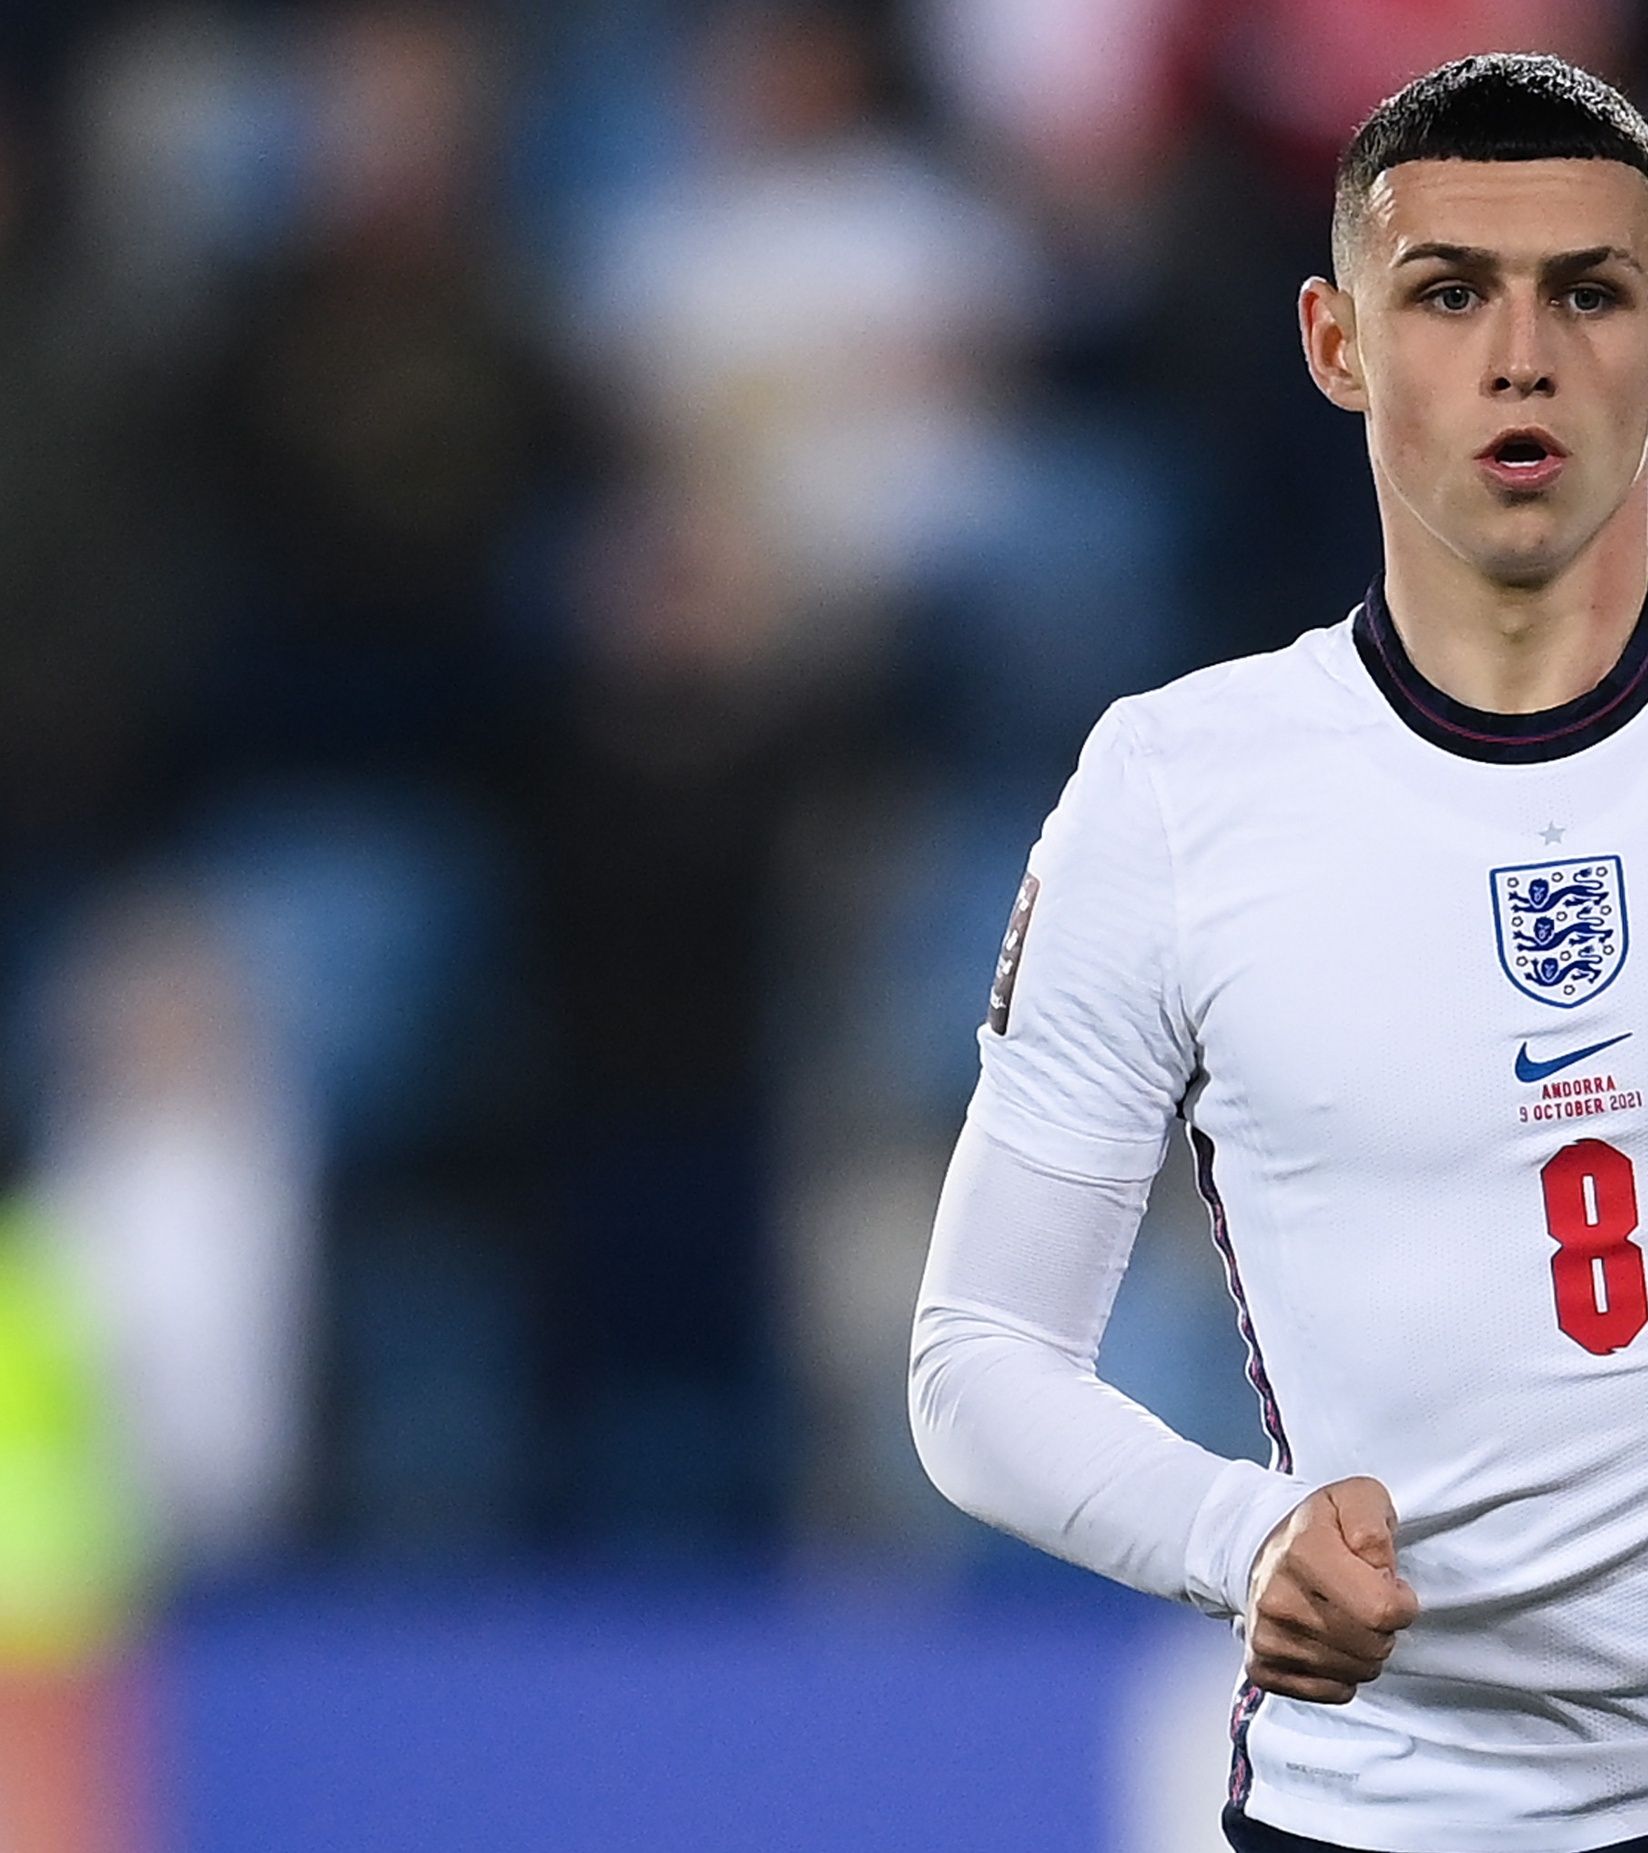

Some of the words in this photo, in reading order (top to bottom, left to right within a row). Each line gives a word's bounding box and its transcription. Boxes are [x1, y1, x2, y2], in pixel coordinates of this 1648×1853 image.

[1541, 1075, 1616, 1100] ANDORRA
[1519, 1105, 1529, 1123] 9
[1533, 1098, 1605, 1121] OCTOBER
[1609, 1091, 1643, 1111] 2021
[1541, 1138, 1648, 1355] 8
